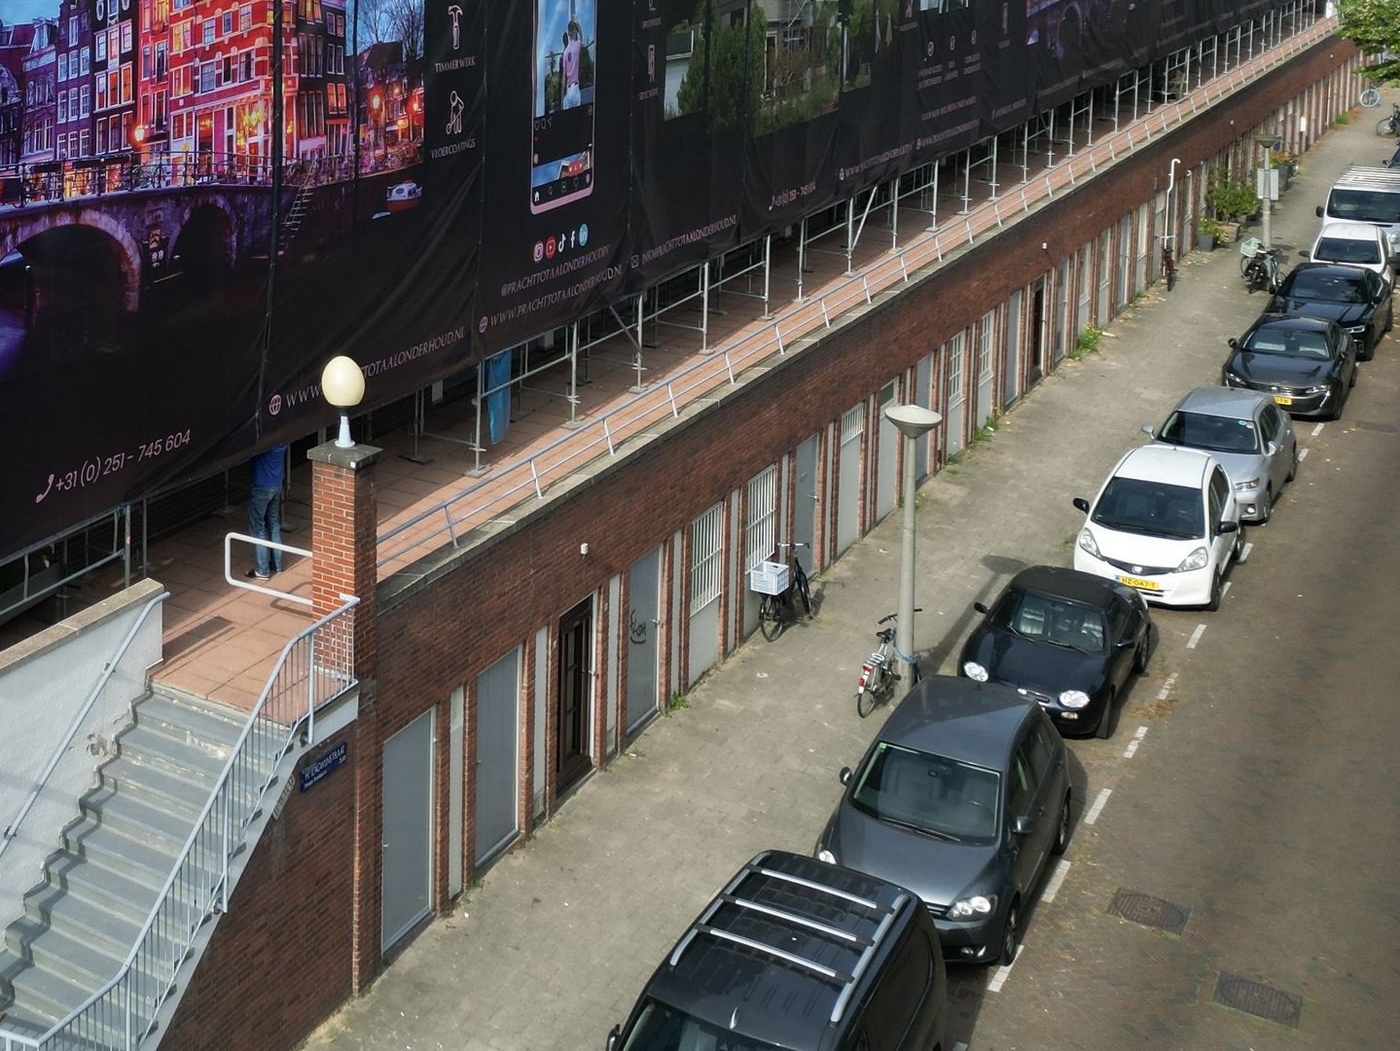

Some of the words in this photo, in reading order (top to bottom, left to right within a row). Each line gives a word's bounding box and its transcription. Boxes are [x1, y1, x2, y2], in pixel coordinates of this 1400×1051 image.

[56, 470, 77, 491] +31
[80, 456, 101, 488] (0)
[138, 438, 163, 462] 745
[165, 428, 191, 452] 604
